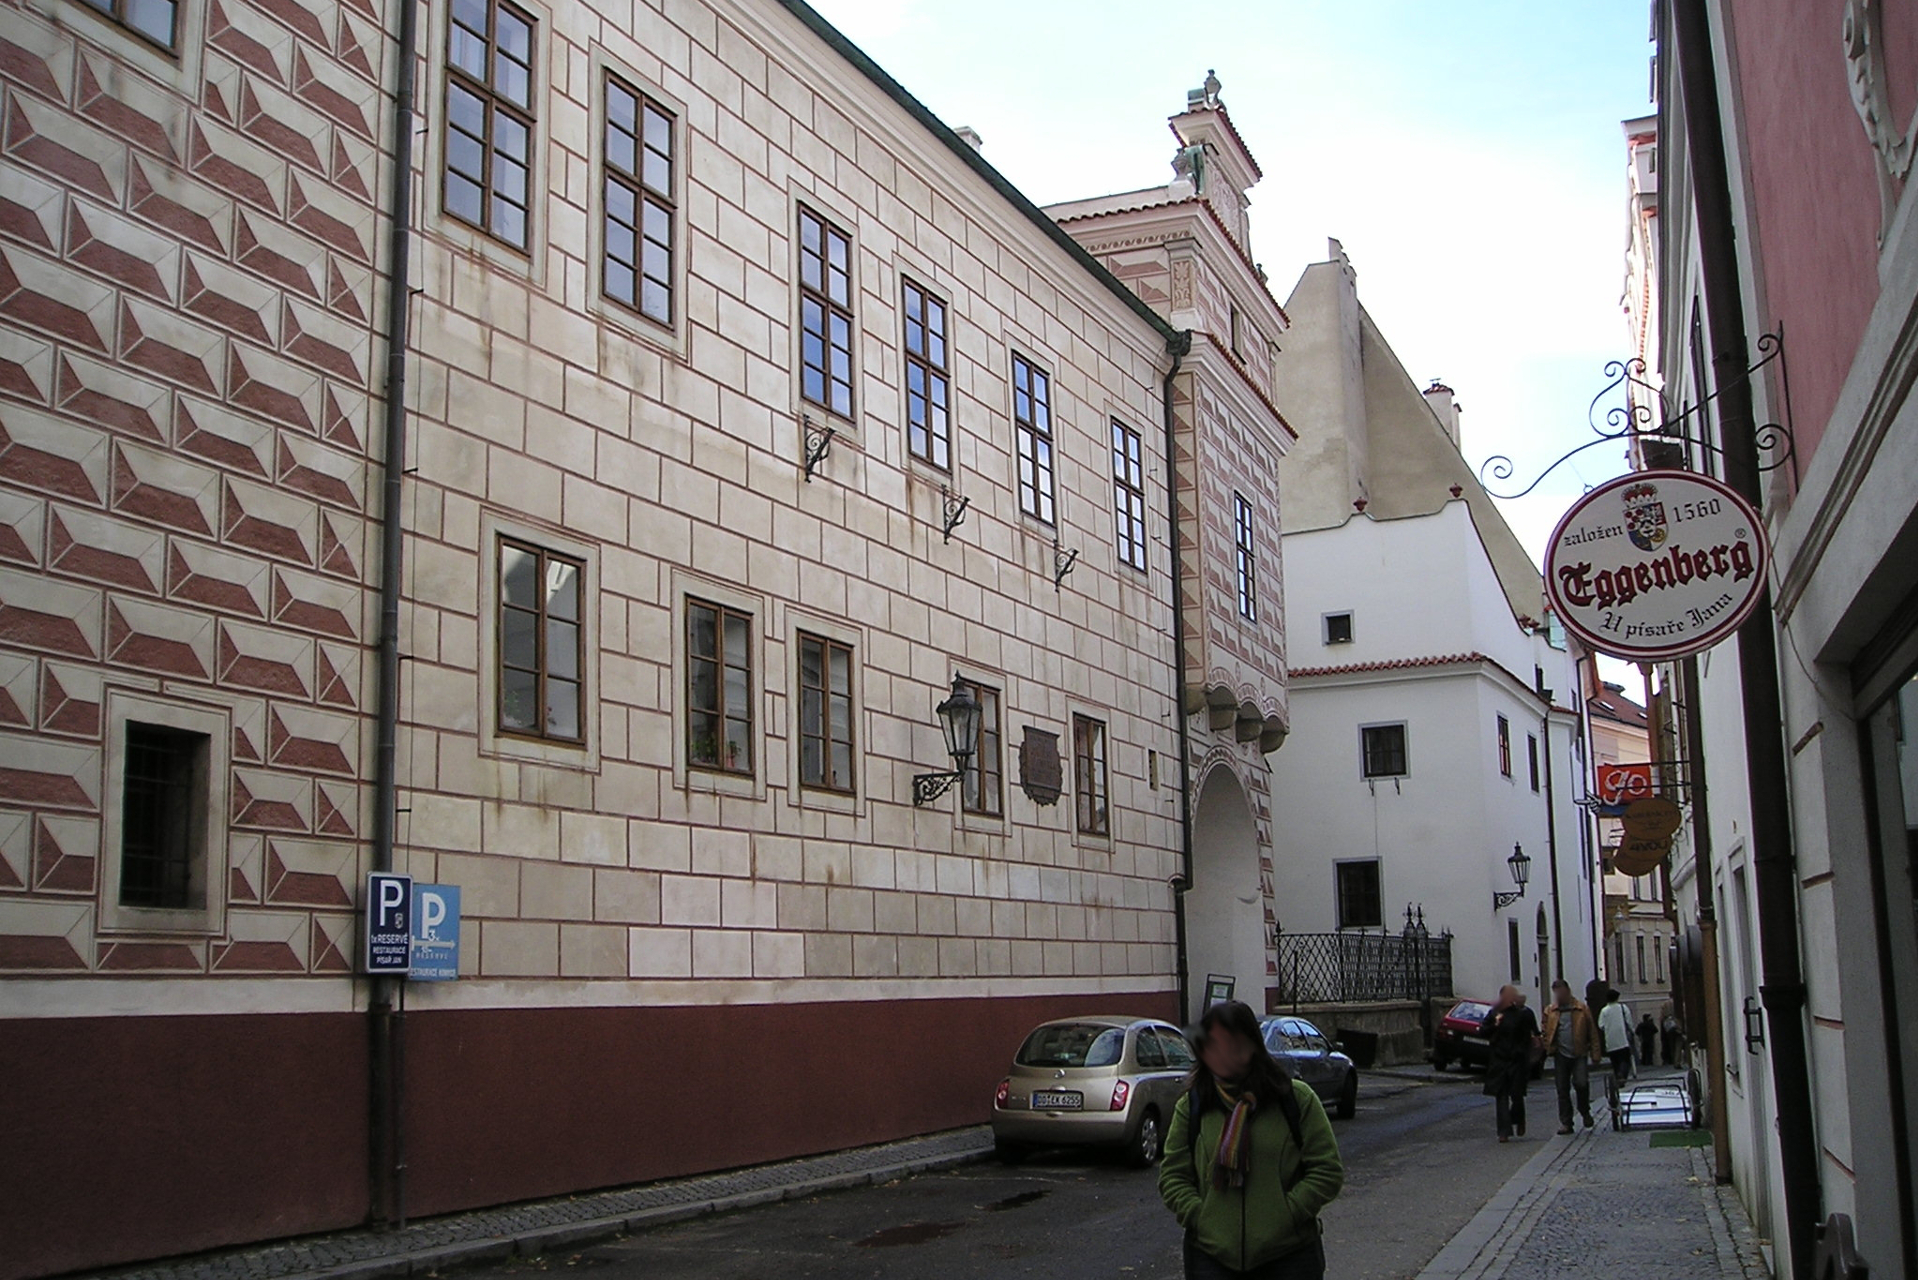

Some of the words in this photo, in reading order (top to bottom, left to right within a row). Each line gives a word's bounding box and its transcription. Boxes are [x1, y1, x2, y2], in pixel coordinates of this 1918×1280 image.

[1563, 524, 1623, 547] založen
[1673, 498, 1722, 523] 1560
[1558, 540, 1754, 611] Eggenberg
[1600, 611, 1622, 633] U
[1625, 619, 1685, 640] písaře
[380, 880, 404, 927] P
[421, 892, 446, 939] P
